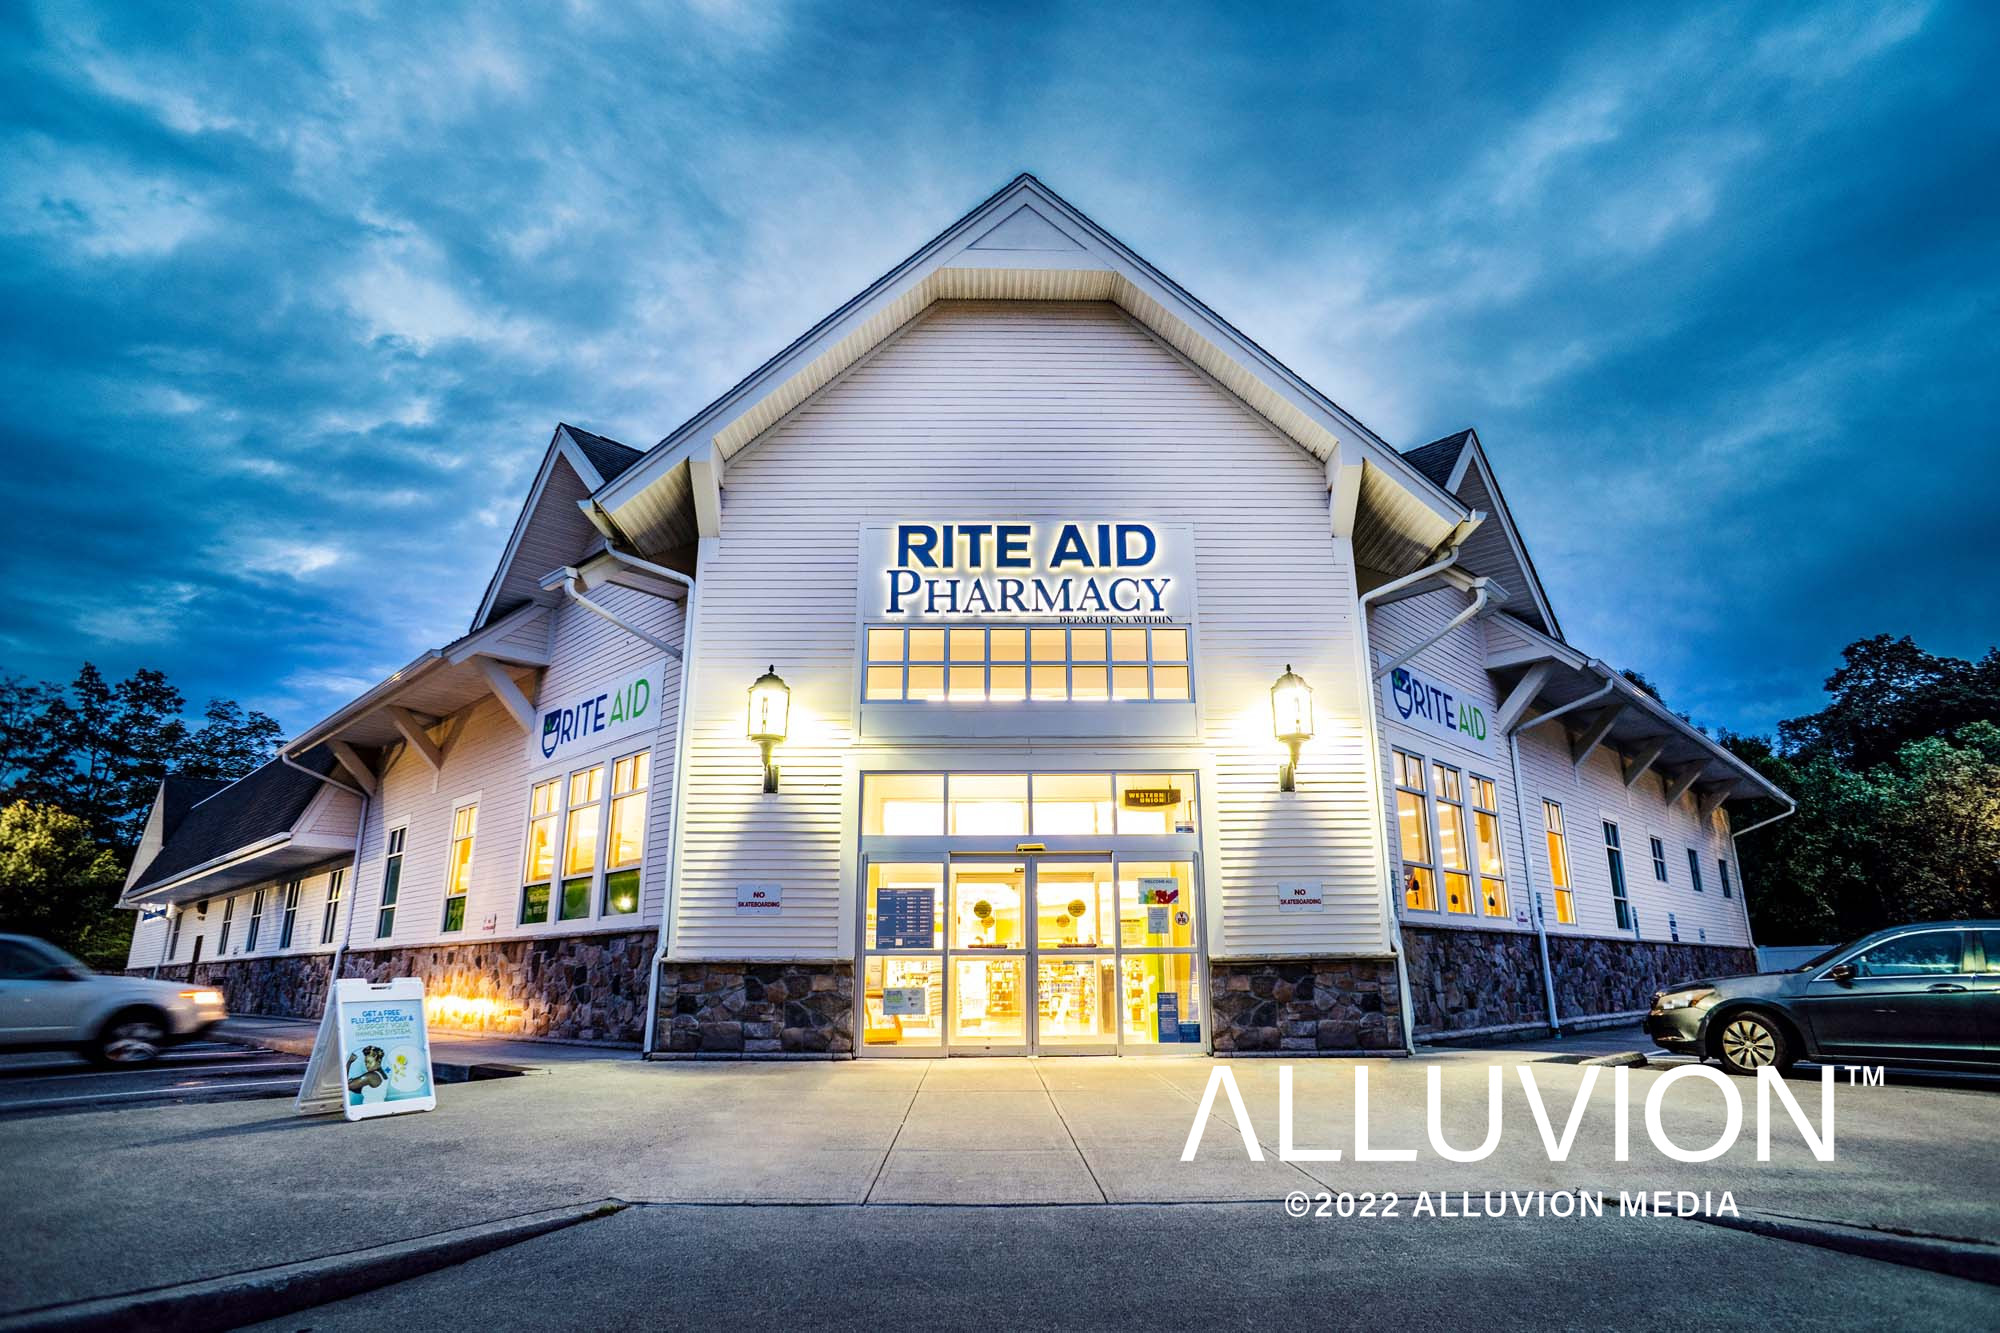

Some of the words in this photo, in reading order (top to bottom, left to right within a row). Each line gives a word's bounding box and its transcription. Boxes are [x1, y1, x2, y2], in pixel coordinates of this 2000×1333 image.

[898, 524, 1031, 568] RITE
[1049, 524, 1156, 568] AID
[885, 569, 1171, 614] PHARMACY
[1059, 615, 1131, 625] DEPARTMENT
[1131, 615, 1173, 625] WITHIN
[560, 693, 608, 745] RITE
[608, 678, 650, 728] AID
[1411, 678, 1457, 731] RITE
[1459, 701, 1486, 741] AID
[752, 891, 766, 899] NO
[1294, 888, 1306, 896] NO
